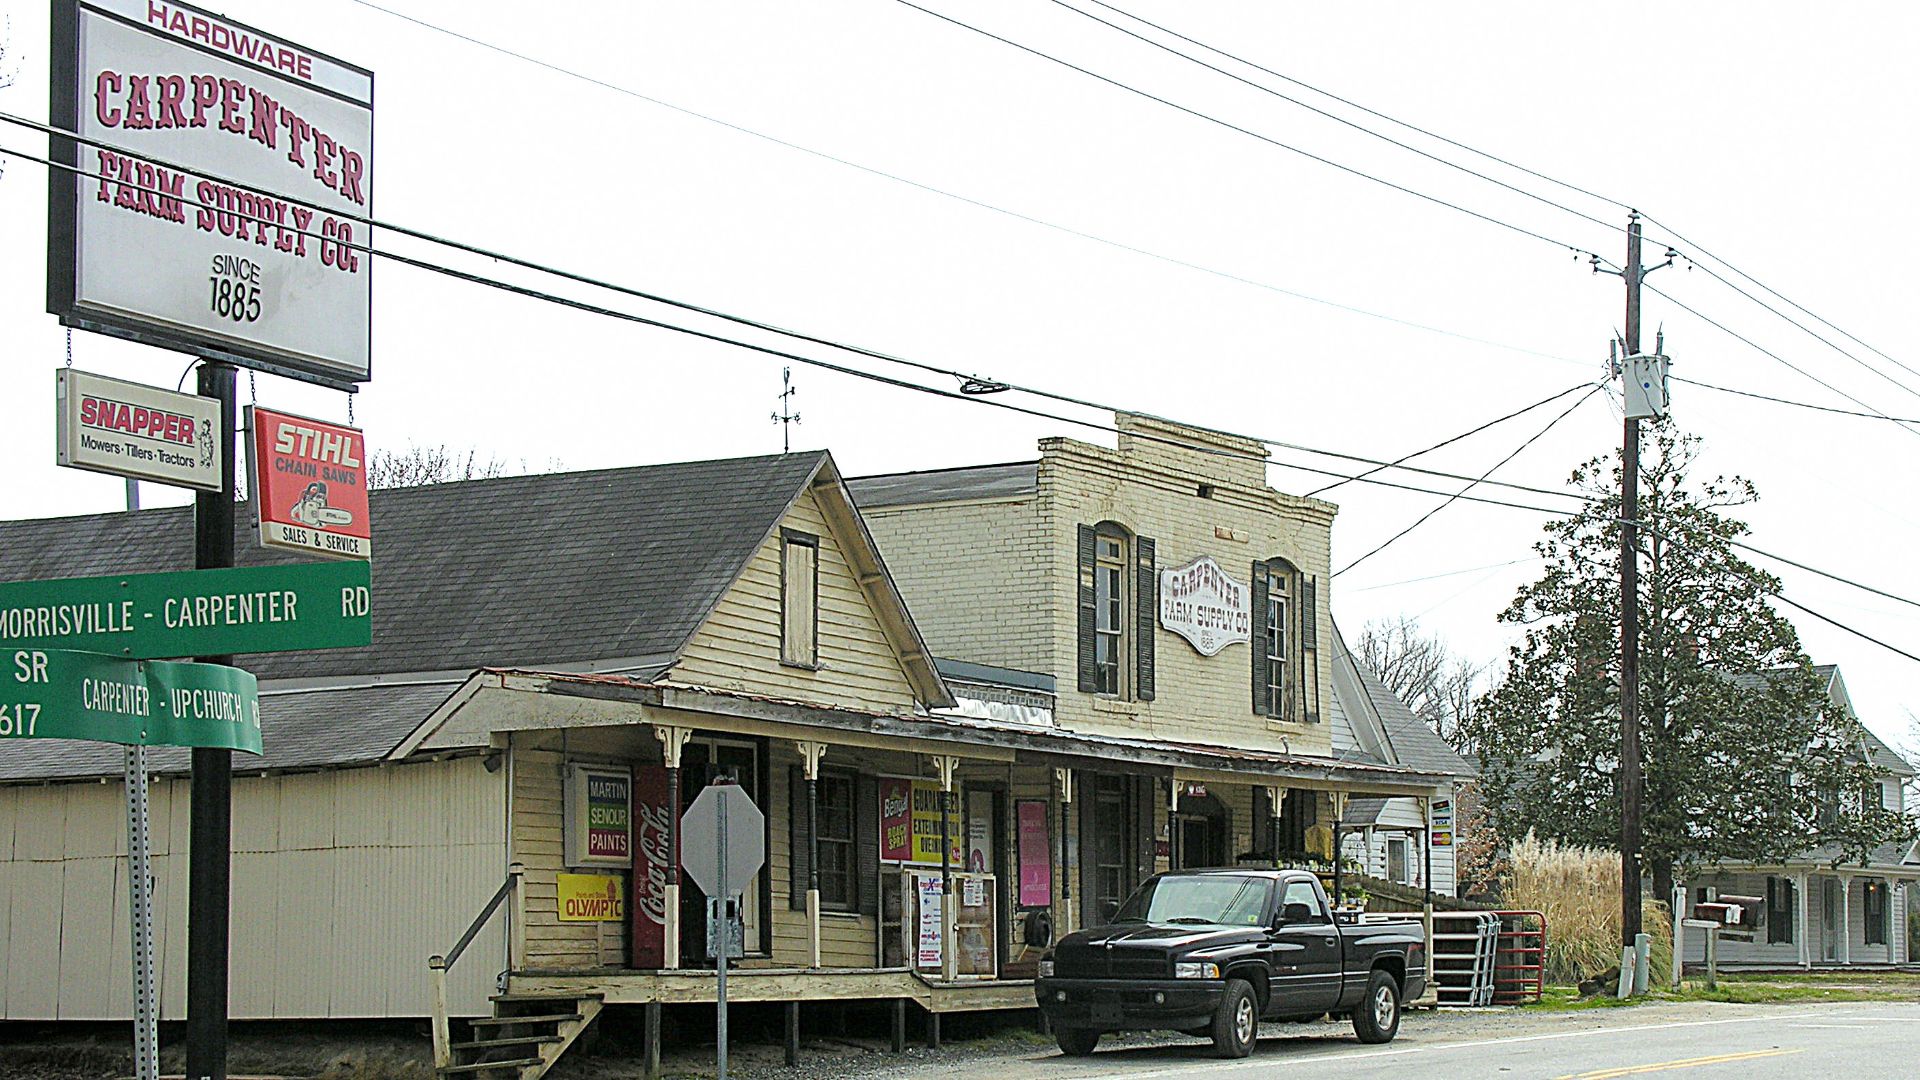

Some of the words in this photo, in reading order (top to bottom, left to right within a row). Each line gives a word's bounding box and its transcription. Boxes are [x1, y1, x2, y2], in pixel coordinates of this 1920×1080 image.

[148, 0, 312, 80] HARDWARE
[94, 70, 365, 206] CARPENTER
[97, 150, 186, 225] FARM
[197, 180, 313, 257] SUPPLY
[321, 216, 359, 273] CO.
[212, 254, 260, 285] SINCE
[210, 276, 262, 322] 1885
[80, 397, 195, 445] SNAPPER
[157, 450, 195, 468] Tractors
[274, 422, 361, 469] STIHL
[275, 458, 317, 478] CHAIN
[322, 466, 357, 486] SAWS
[283, 526, 307, 545] SALES
[314, 532, 321, 547] &
[326, 535, 360, 553] SERVICE
[1172, 563, 1240, 609] CARPENTER
[164, 591, 297, 629] CARPENTER
[341, 586, 370, 618] RD
[1197, 605, 1234, 631] SUPPLY
[14, 650, 49, 684] SR
[83, 678, 150, 717] CARPENTER
[171, 688, 243, 722] UPCHURCH
[590, 781, 627, 800] MARTIN
[884, 791, 909, 818] Bengal
[590, 807, 626, 826] SENOUR
[590, 834, 627, 851] PAINTS
[566, 898, 622, 917] OLYMPIC
